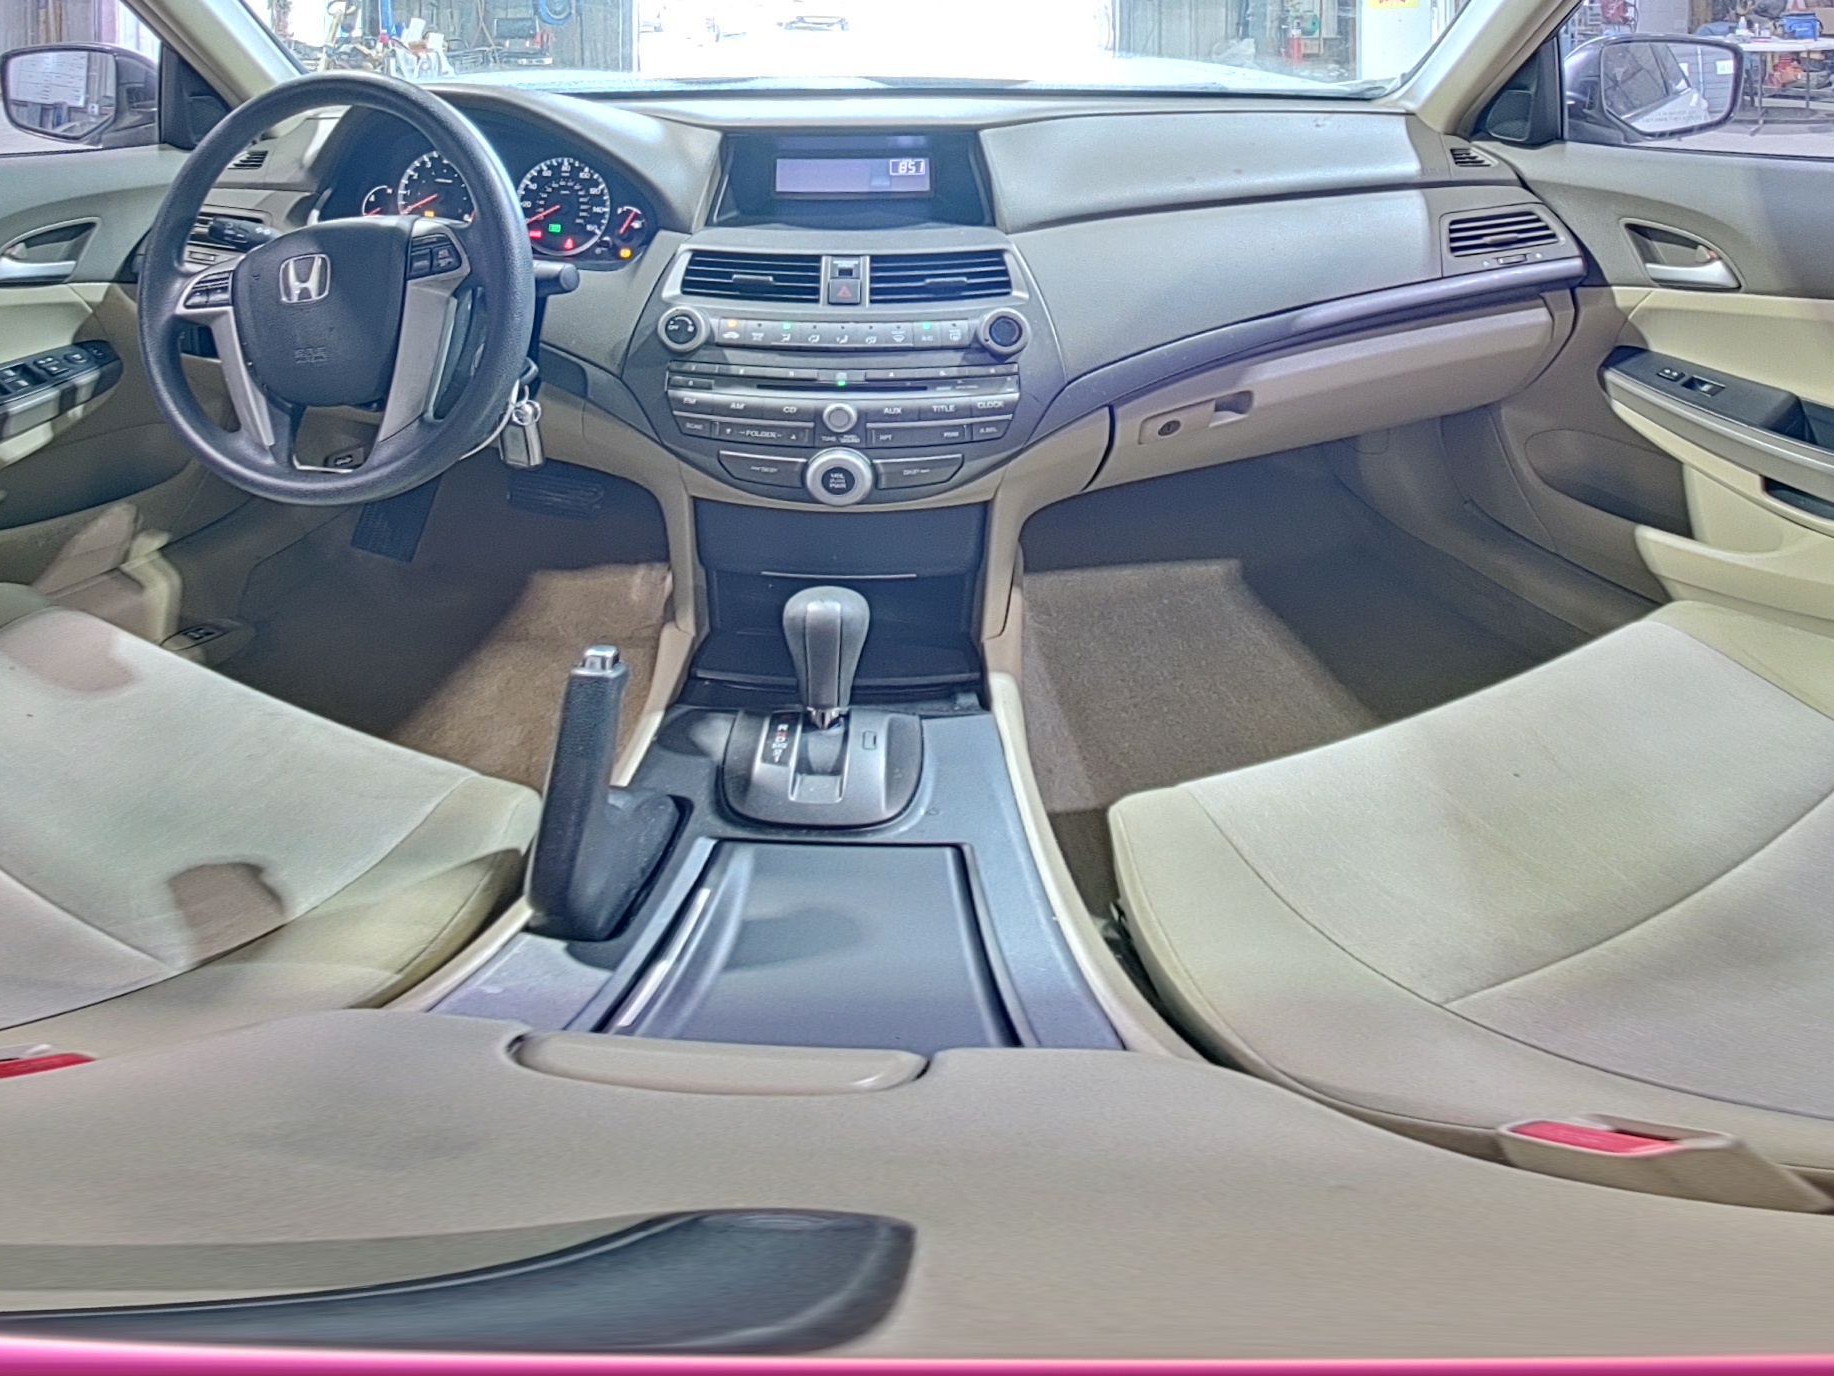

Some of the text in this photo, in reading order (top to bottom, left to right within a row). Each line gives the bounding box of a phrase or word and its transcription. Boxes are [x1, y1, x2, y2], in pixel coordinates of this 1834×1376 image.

[932, 404, 955, 412] TITLE
[976, 401, 1004, 409] CLOCK
[745, 430, 777, 438] FOLDER
